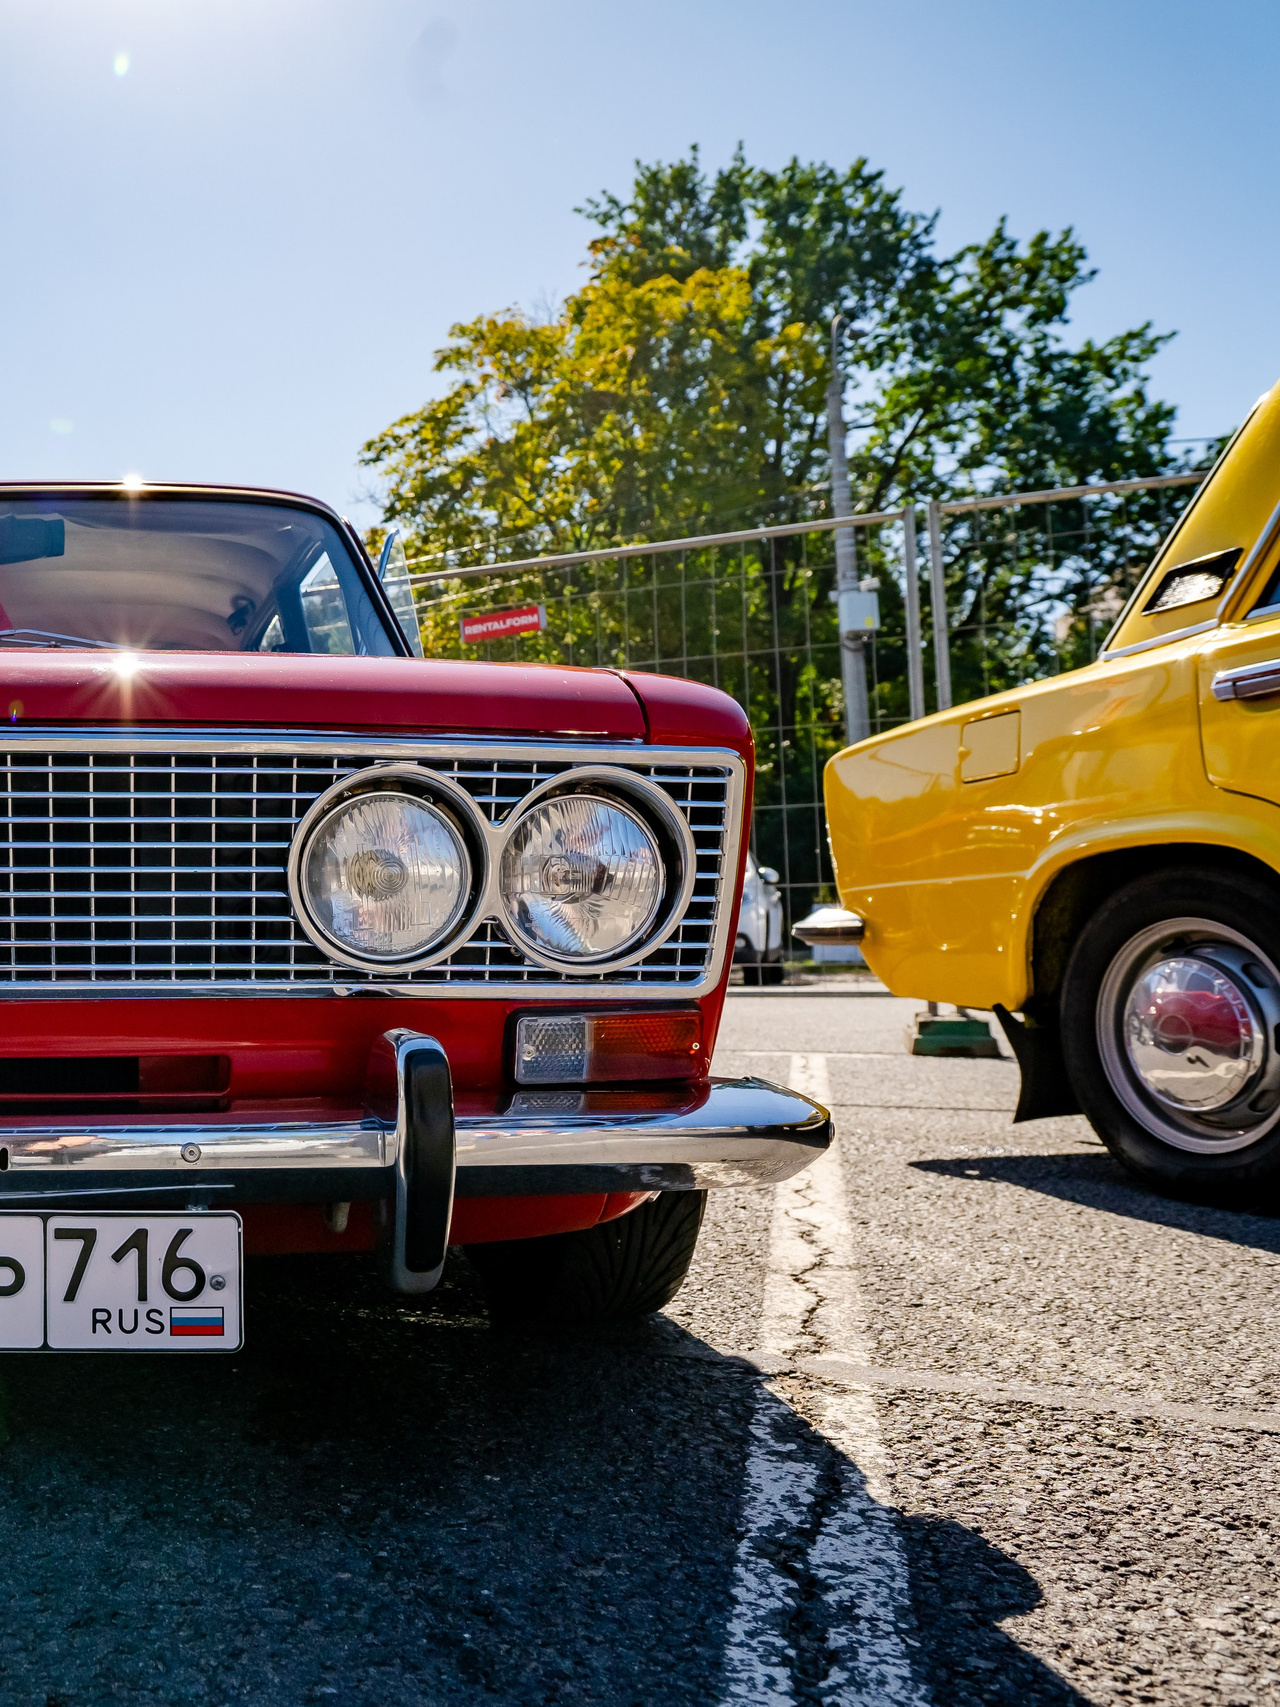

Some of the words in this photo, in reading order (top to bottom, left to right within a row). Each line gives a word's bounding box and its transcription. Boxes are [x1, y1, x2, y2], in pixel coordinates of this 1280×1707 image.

[464, 614, 538, 635] RENTALFORM
[54, 1228, 206, 1301] 716
[92, 1308, 165, 1334] RUS
